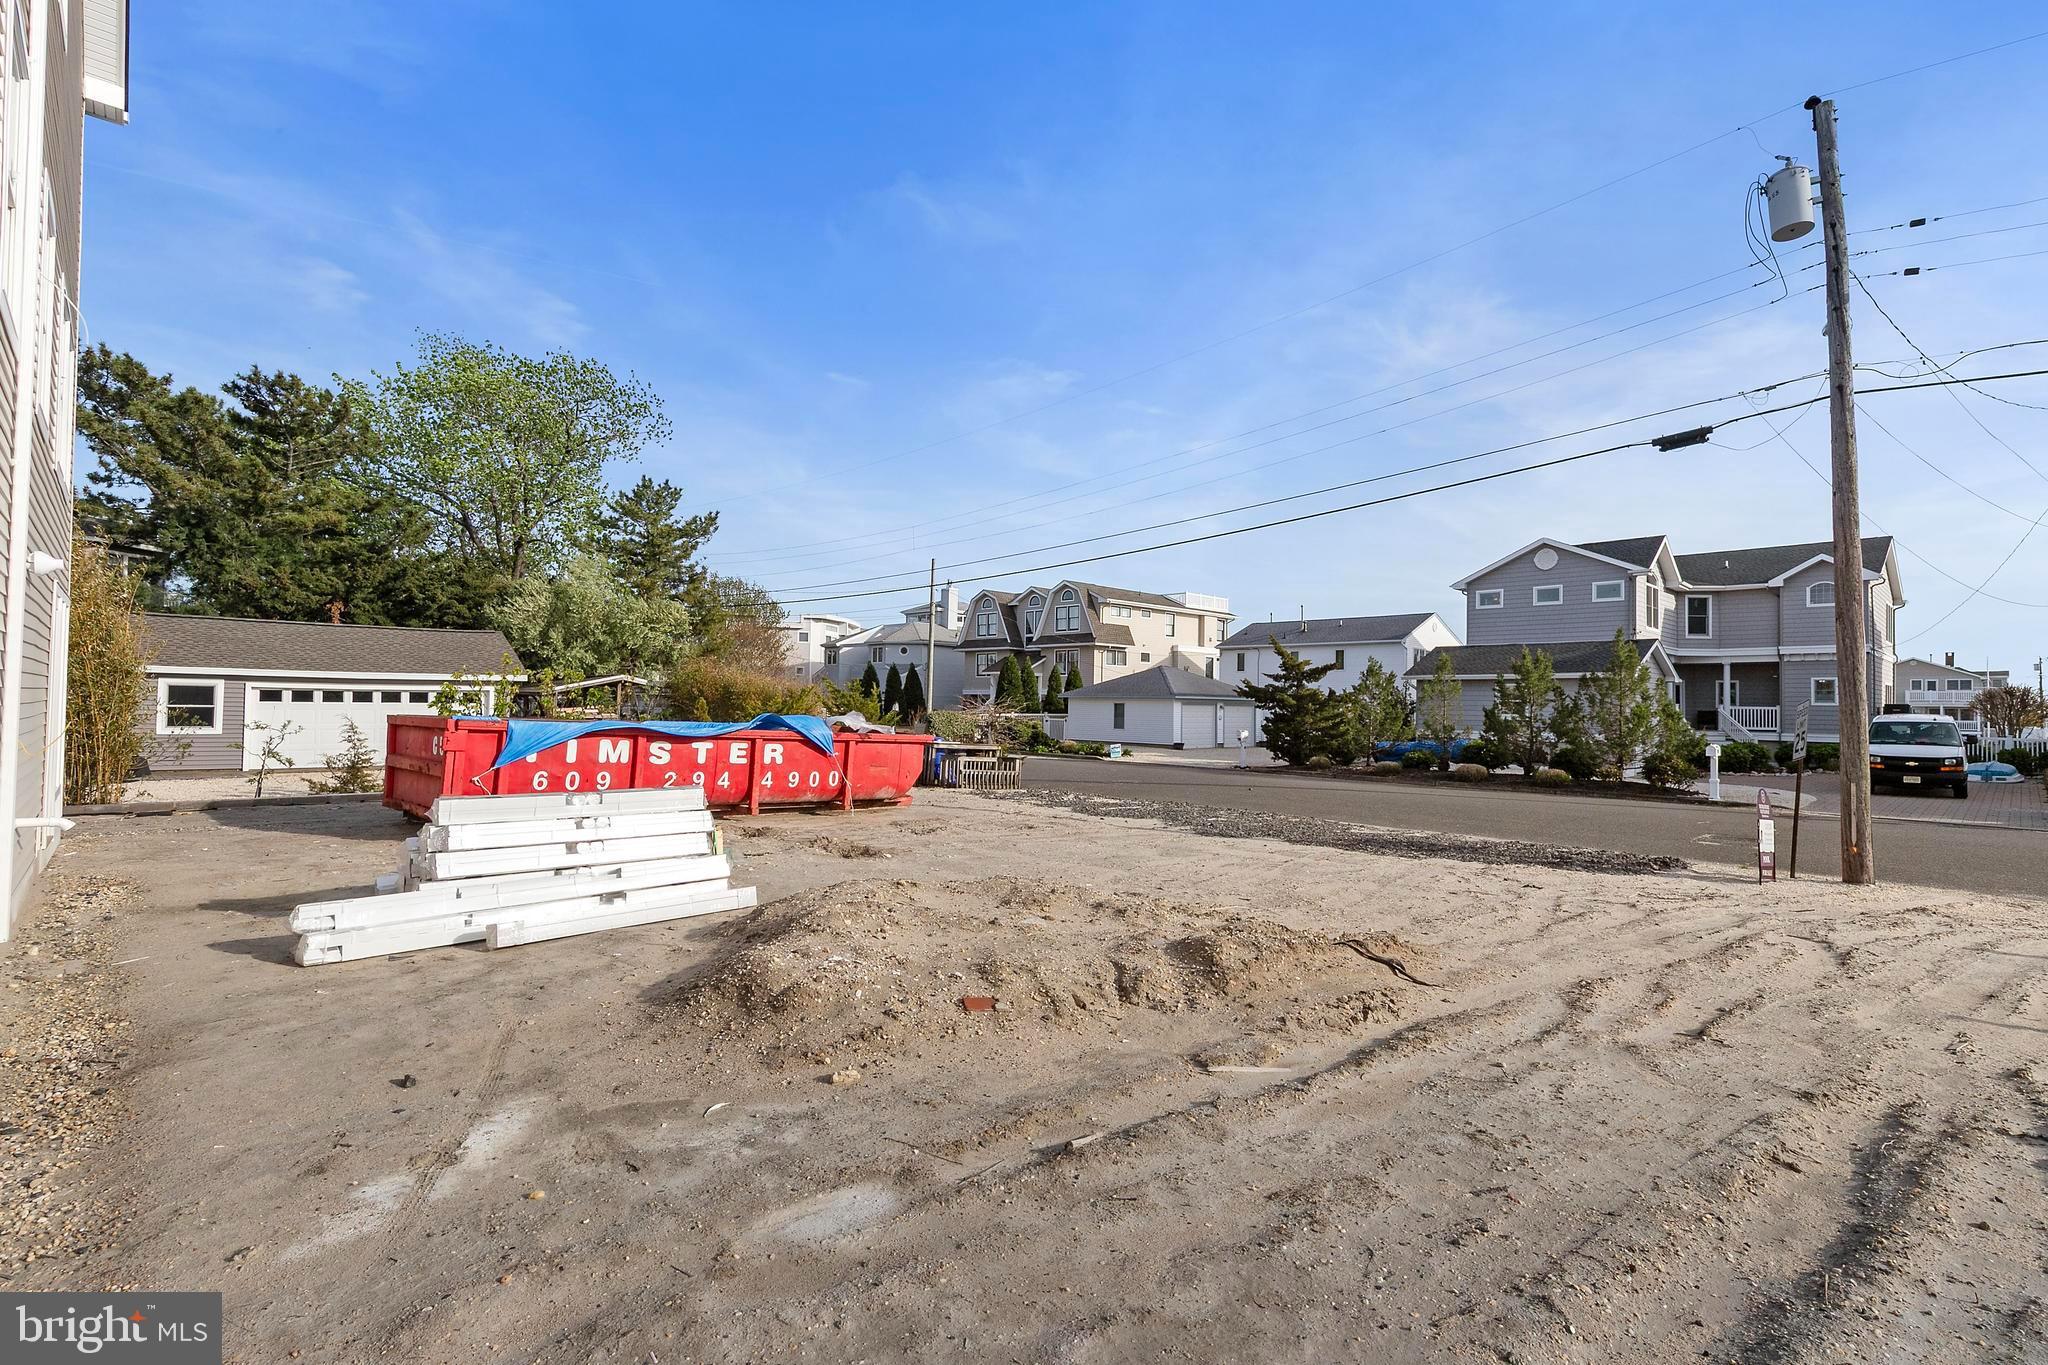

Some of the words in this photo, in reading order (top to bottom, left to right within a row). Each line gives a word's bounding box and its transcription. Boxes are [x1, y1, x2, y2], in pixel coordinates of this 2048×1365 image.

[525, 739, 784, 764] IMSTER
[1795, 730, 1806, 753] 25
[532, 771, 611, 791] 609
[664, 771, 730, 788] 294
[761, 770, 839, 788] 4900
